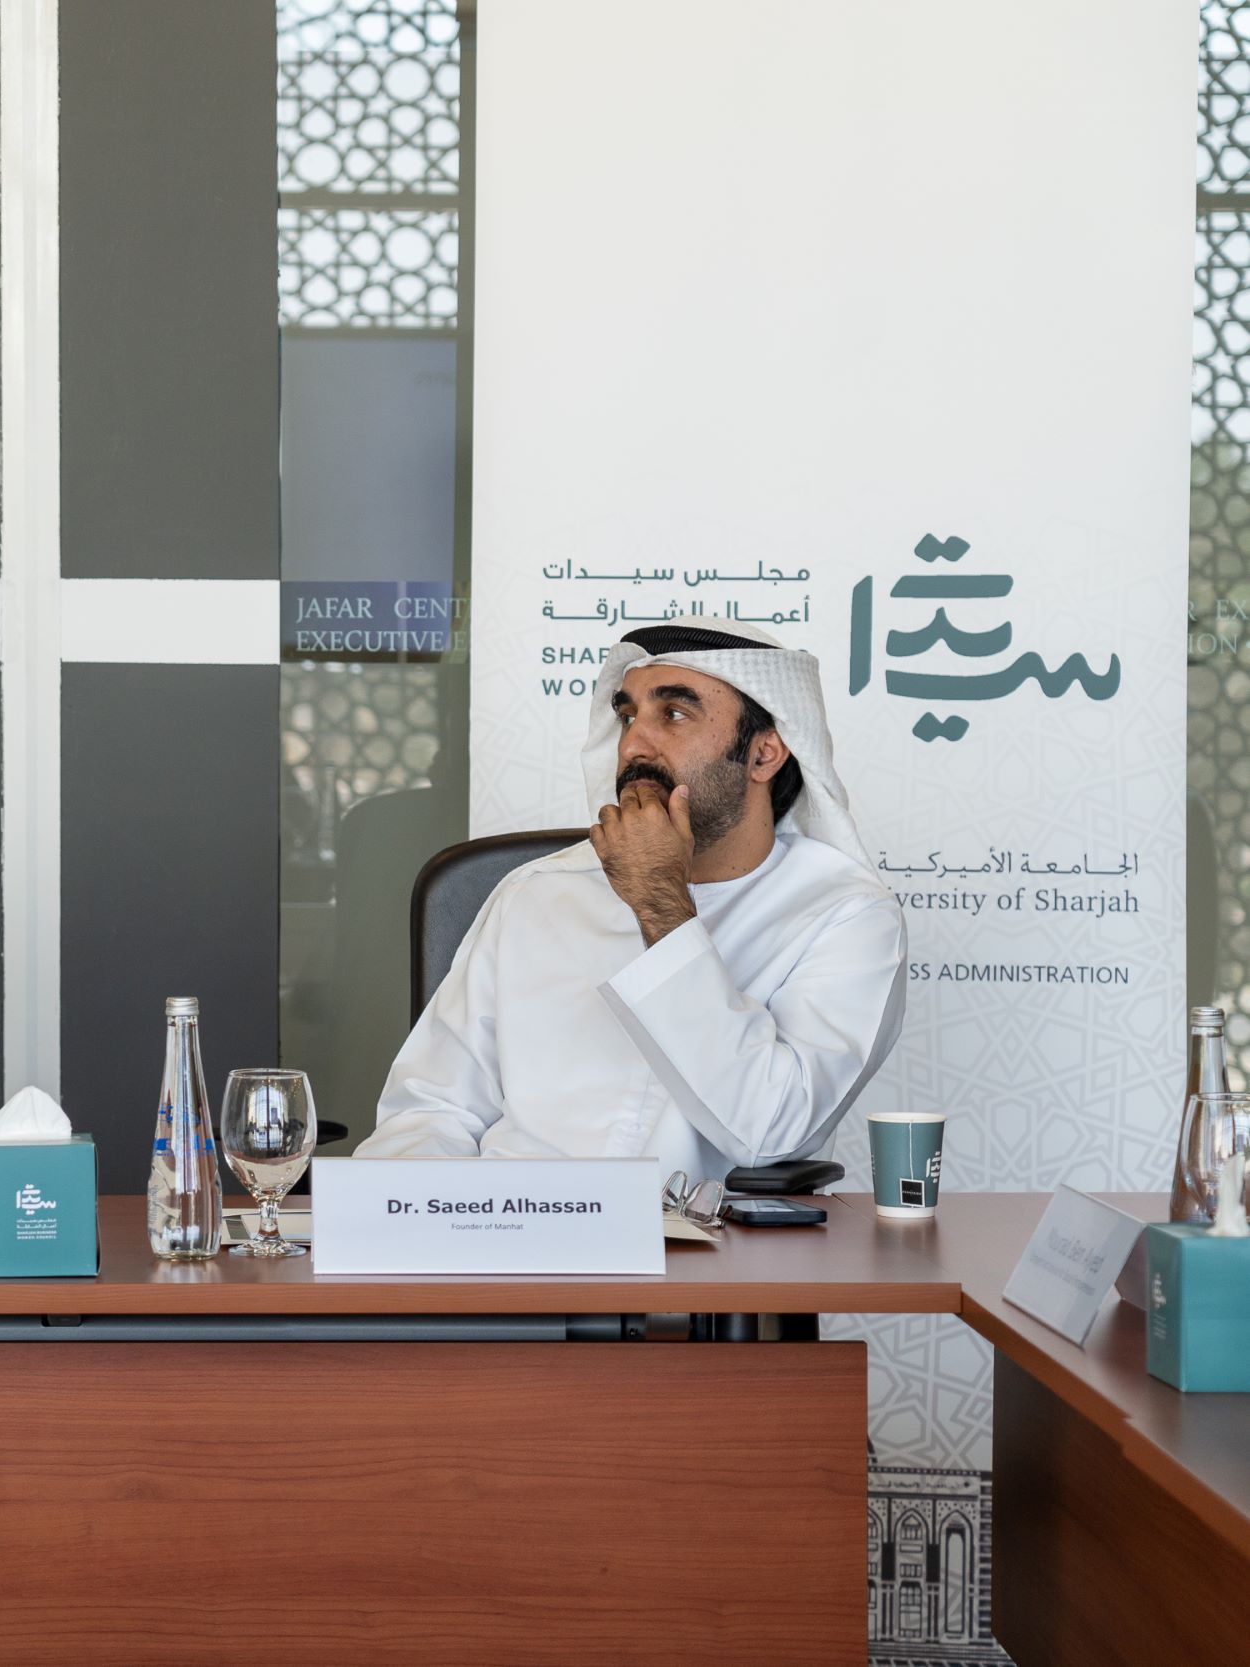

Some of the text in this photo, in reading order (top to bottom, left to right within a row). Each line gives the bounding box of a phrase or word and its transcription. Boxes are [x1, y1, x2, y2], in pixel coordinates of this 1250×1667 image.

[542, 558, 811, 588] مجلس سيدات
[296, 597, 374, 623] JAFAR
[296, 629, 444, 652] EXECUTIVE
[542, 678, 599, 697] WO
[877, 846, 1139, 879] الجامعة الأميركية
[887, 886, 1139, 919] versity of Sharjah
[937, 963, 1129, 984] ADMINISTRATION
[387, 1197, 602, 1214] Dr. Saeed Alhassan
[451, 1222, 484, 1231] Founder
